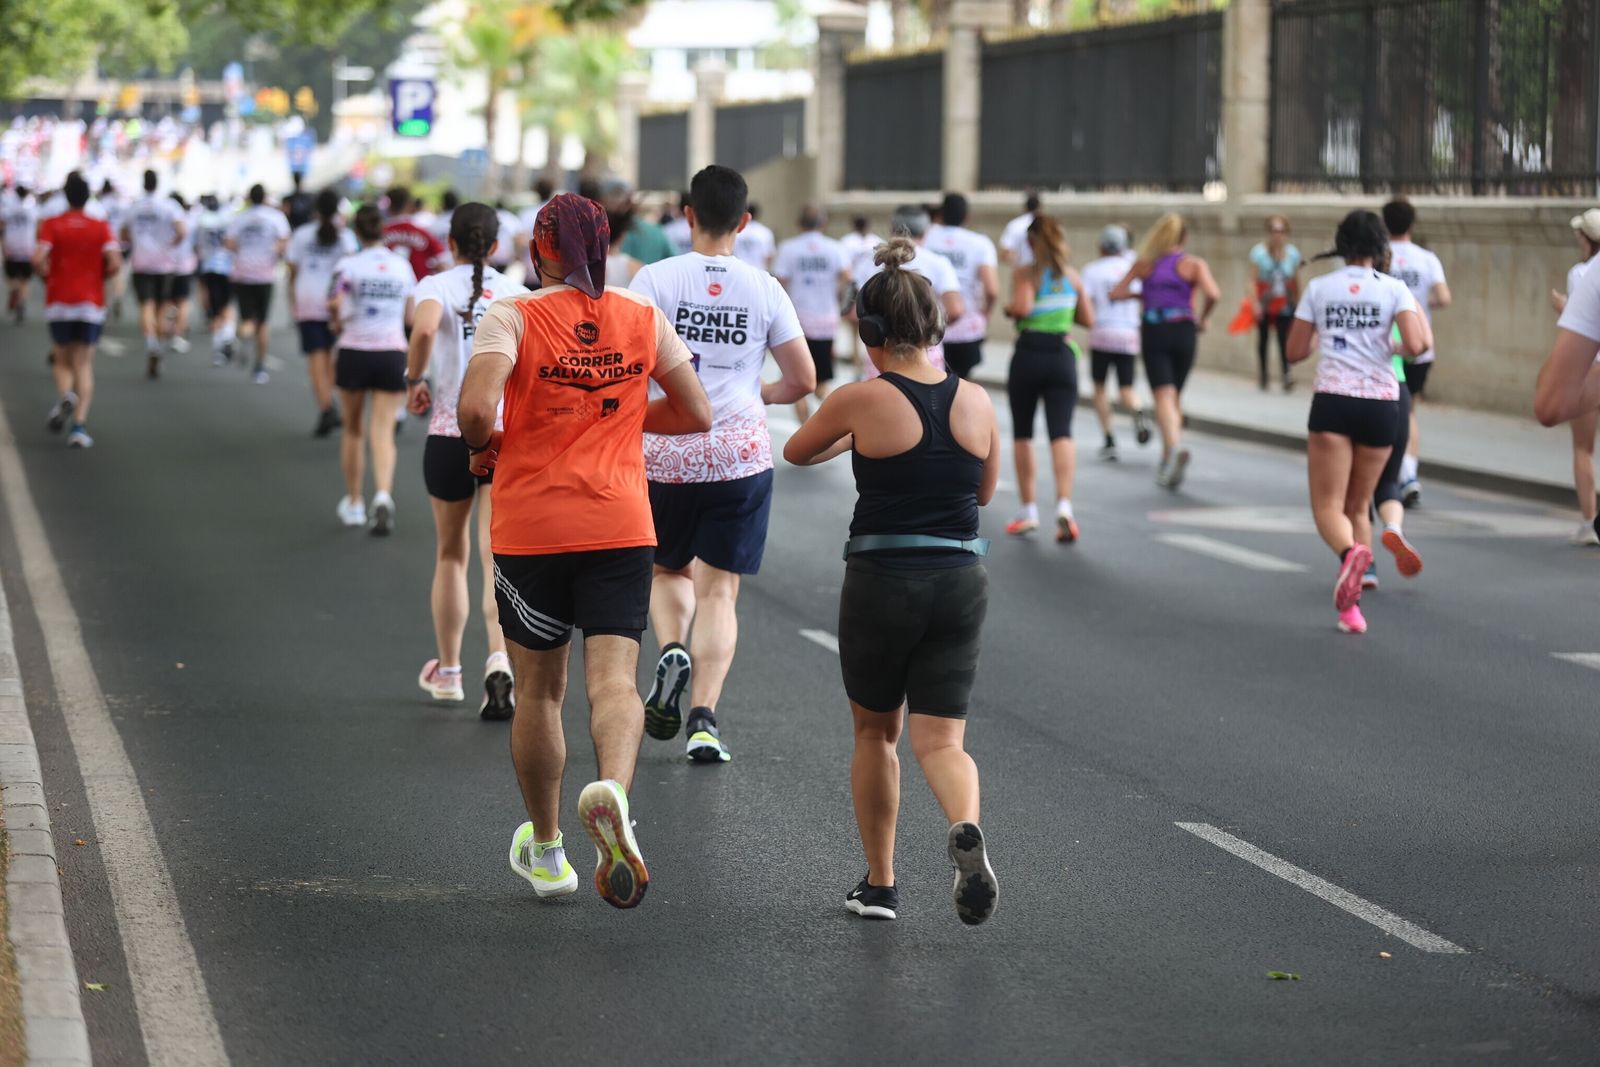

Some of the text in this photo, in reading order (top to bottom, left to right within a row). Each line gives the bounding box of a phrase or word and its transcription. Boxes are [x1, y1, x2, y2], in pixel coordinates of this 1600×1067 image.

[398, 82, 431, 119] P
[711, 305, 749, 313] CARRERAS
[1326, 305, 1380, 316] PONLE
[676, 307, 748, 329] PONLE
[1326, 318, 1380, 330] FRENO
[675, 323, 747, 345] FRENO
[559, 353, 623, 367] CORRER
[539, 363, 644, 379] SALVA VIDAS
